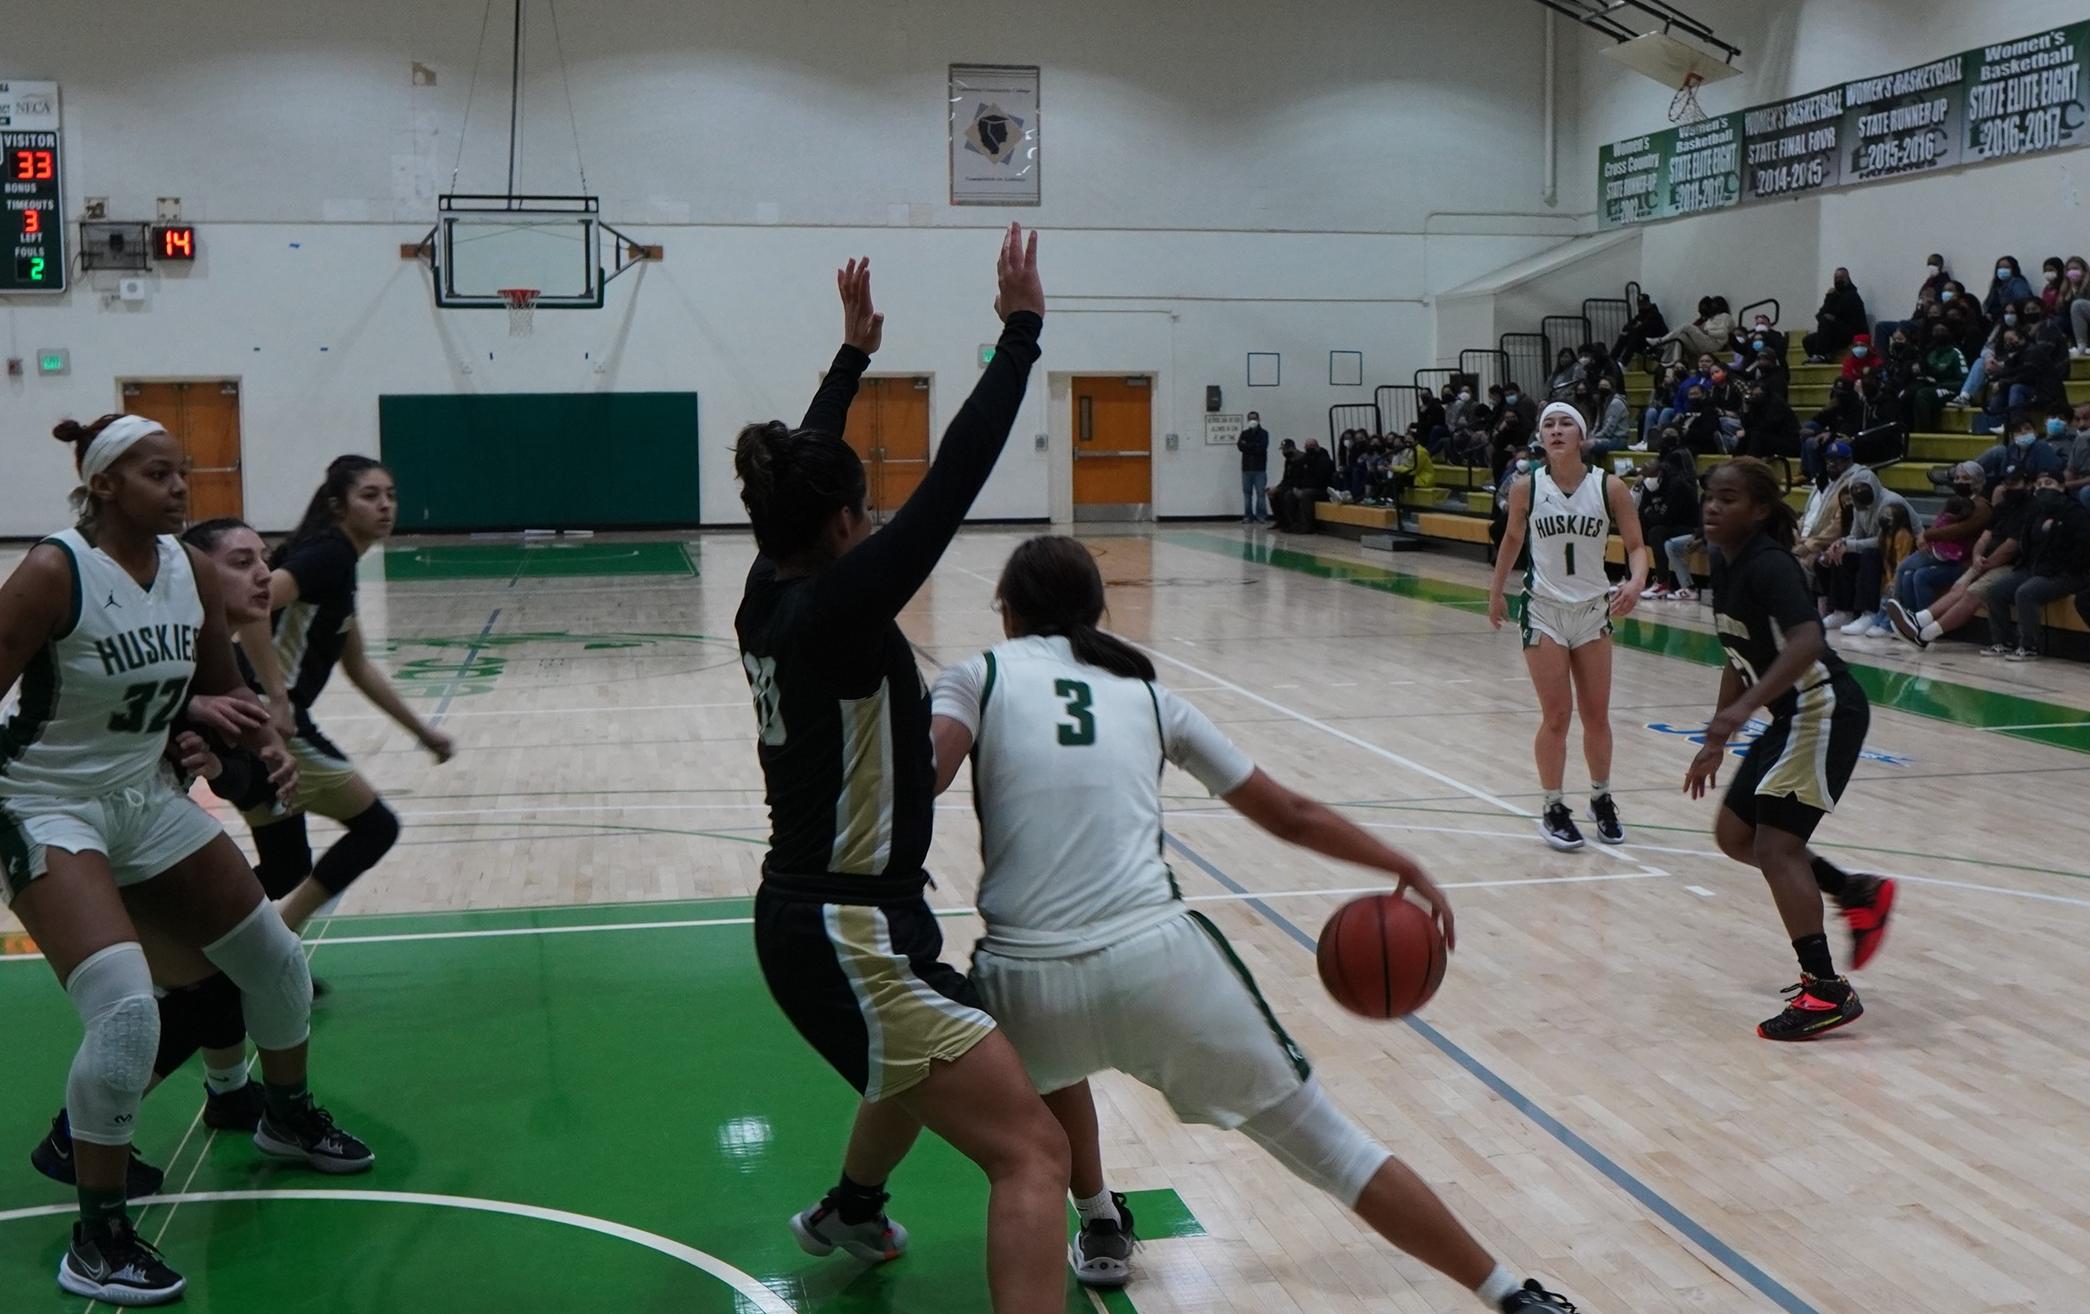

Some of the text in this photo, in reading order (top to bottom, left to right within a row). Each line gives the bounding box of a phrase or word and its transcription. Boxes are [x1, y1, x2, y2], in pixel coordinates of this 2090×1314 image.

[1985, 31, 2066, 62] Women's
[1981, 45, 2074, 81] Basketball
[1845, 56, 1962, 107] WOMEN'S BASKETBALL
[1969, 63, 2080, 121] STATE ELITE EIGHT
[1785, 89, 1843, 128] BASKETBALL
[1679, 118, 1728, 138] Women's
[1858, 112, 1889, 138] STATE
[1983, 106, 2061, 157] 2016-2017
[4, 133, 55, 148] VISITOR
[1676, 129, 1733, 153] Basketball
[1748, 126, 1836, 165] STATE FINAL FOUR
[1868, 132, 1935, 171] 2015-2016
[17, 151, 52, 179] 33
[1605, 161, 1627, 177] Cross
[1669, 154, 1691, 184] STATE
[1758, 159, 1822, 194] 2014-2015
[4, 182, 37, 194] BONUS
[7, 199, 54, 210] TIMEOUTS
[24, 209, 39, 232] 3
[20, 232, 43, 244] LEFT
[166, 230, 191, 256] 14
[15, 247, 45, 258] FOULS
[31, 257, 44, 280] 2
[1535, 514, 1604, 539] HUSKIES
[1564, 542, 1576, 576] 1
[106, 675, 189, 734] 32
[1054, 678, 1096, 747] 3
